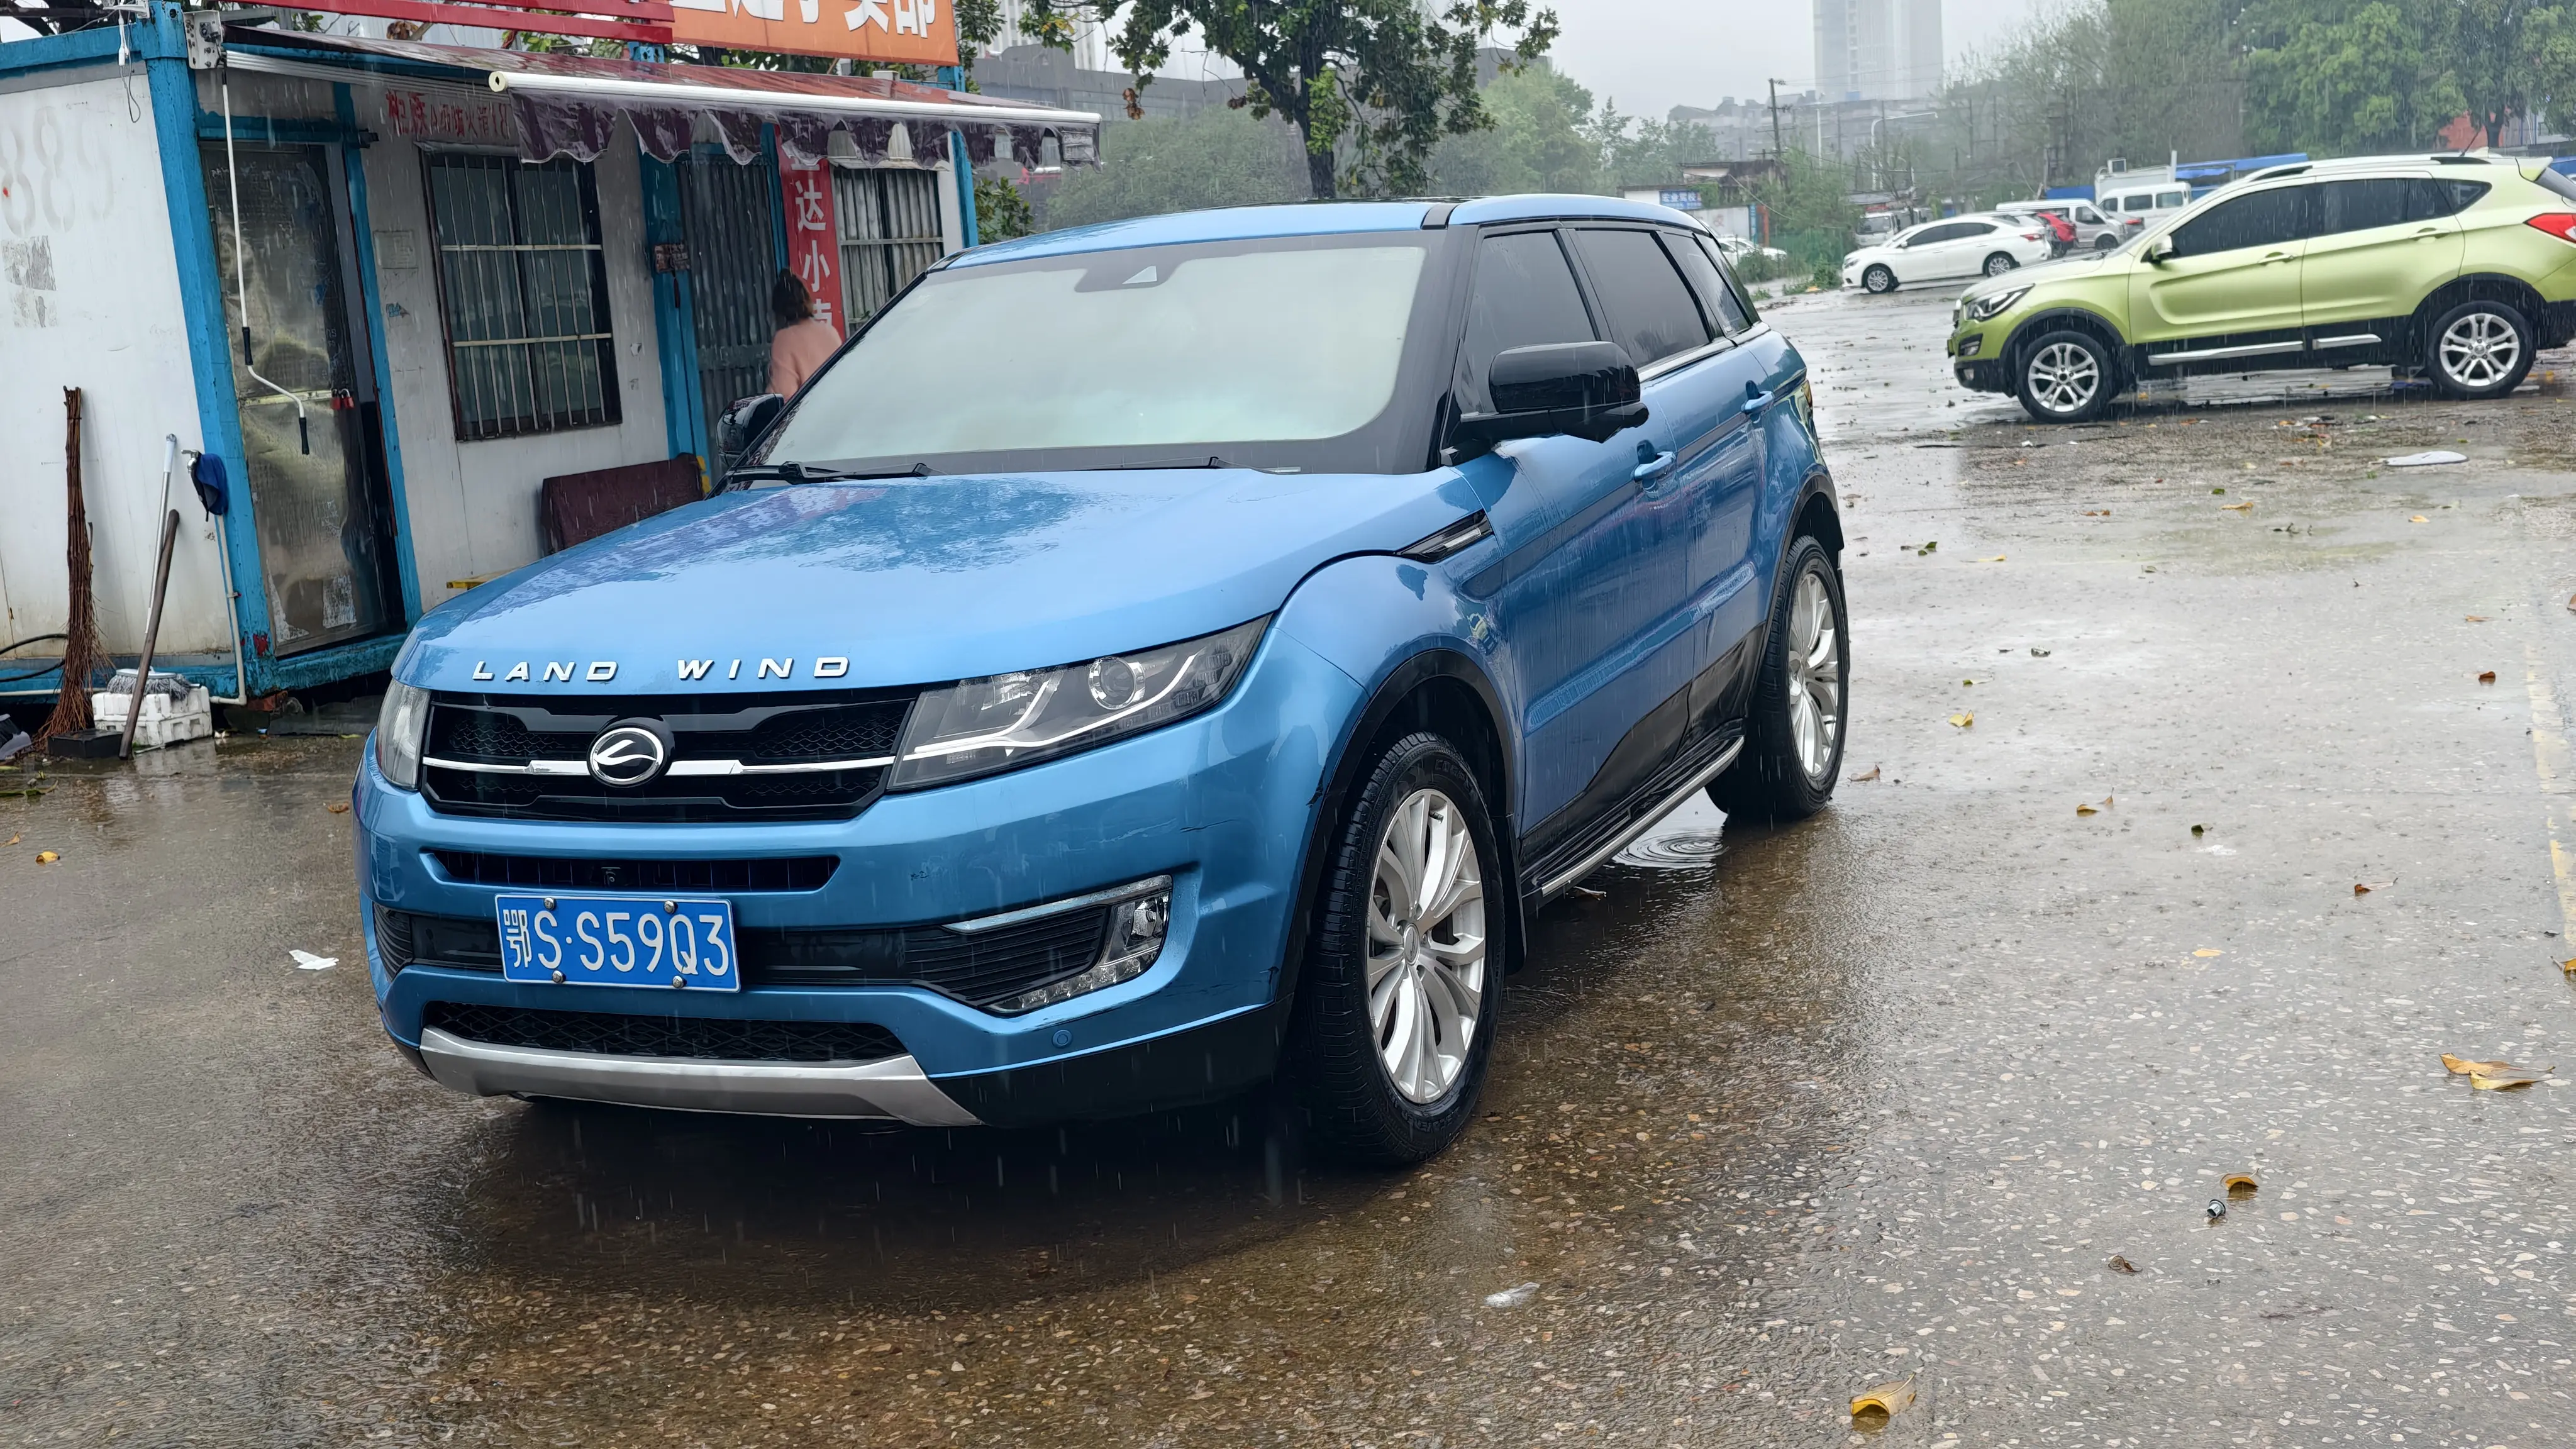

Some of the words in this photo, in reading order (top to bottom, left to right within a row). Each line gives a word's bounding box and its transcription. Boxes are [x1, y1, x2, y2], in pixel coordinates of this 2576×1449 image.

[791, 157, 834, 329] 达小
[472, 660, 619, 682] LAND
[677, 657, 851, 680] WIND
[502, 909, 730, 977] 鄂S·S59Q3
